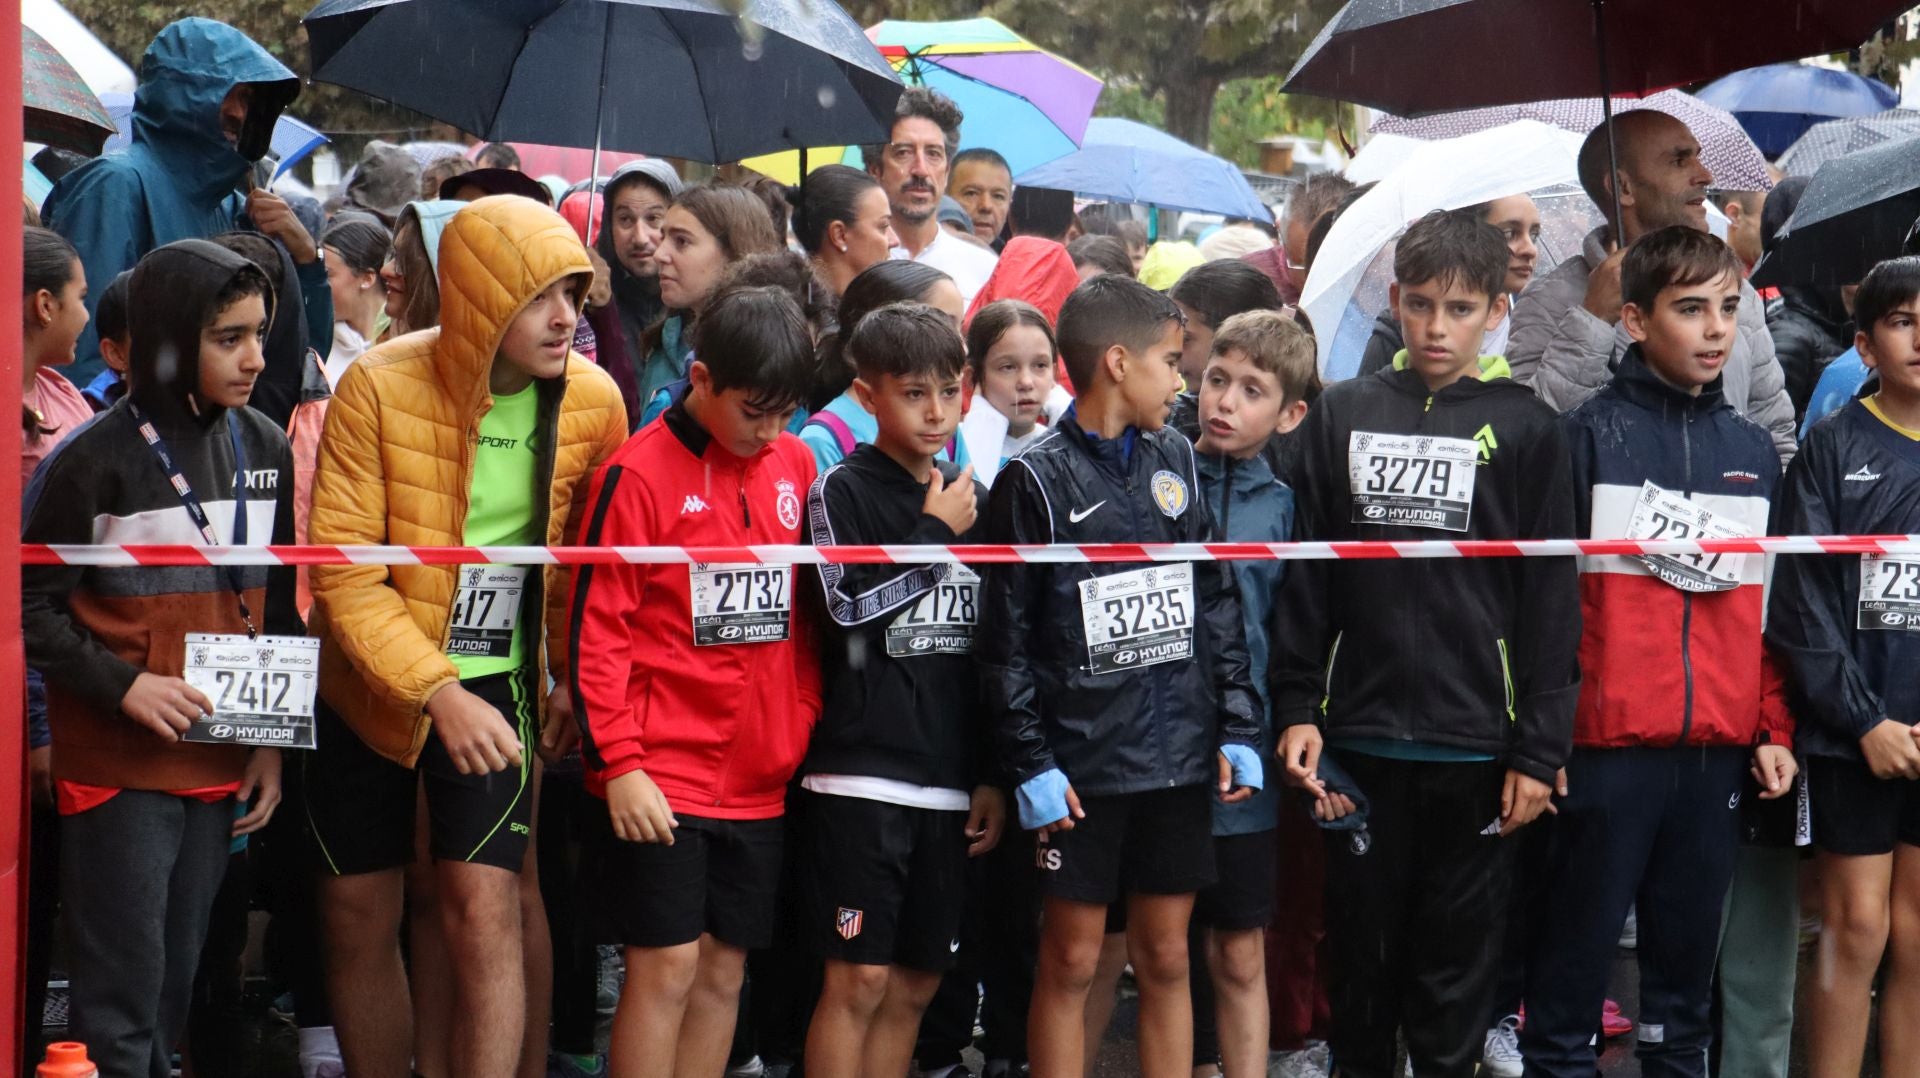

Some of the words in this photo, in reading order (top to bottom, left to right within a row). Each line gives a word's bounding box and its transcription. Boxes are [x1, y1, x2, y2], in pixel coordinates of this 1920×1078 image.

[1366, 456, 1452, 497] 3279
[1388, 508, 1446, 522] HYUNDAI
[714, 570, 784, 613] 2732
[881, 579, 908, 608] NIKE
[1104, 588, 1187, 639] 3235
[215, 671, 290, 713] 2412
[236, 726, 294, 740] HYUNDAI
